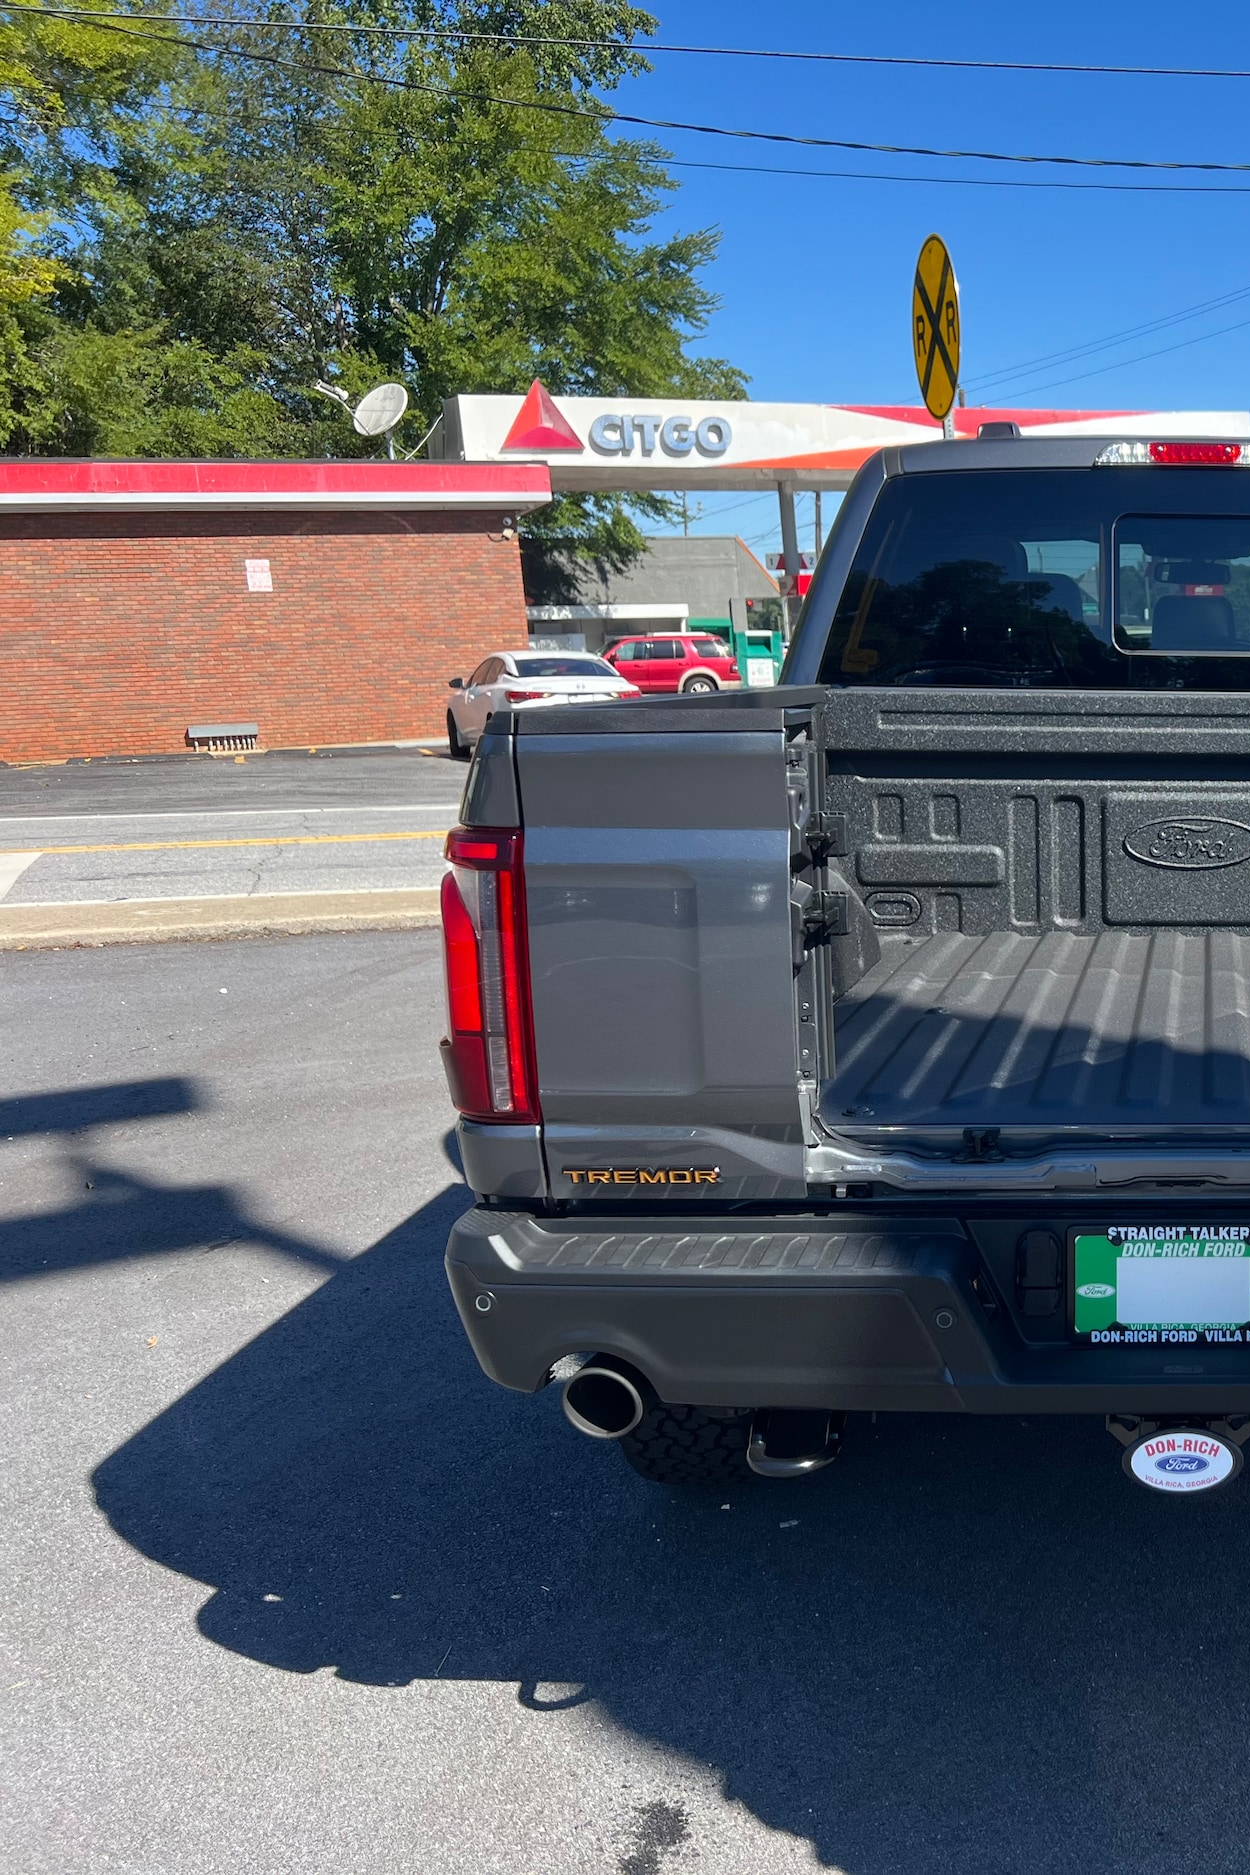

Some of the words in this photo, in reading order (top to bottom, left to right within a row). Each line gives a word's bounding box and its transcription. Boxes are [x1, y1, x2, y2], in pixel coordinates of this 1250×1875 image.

[916, 314, 927, 357] R
[945, 299, 957, 346] R
[589, 414, 732, 457] CITGO
[1149, 823, 1235, 859] Ford
[562, 1167, 721, 1184] TREMOR
[1107, 1226, 1186, 1240] STRAIGHT
[1121, 1242, 1199, 1257] DON-RICH
[1203, 1242, 1246, 1257] FORD
[1083, 1285, 1109, 1296] Ford
[1091, 1330, 1158, 1343] DON-RICH
[1161, 1330, 1197, 1343] FORD
[1204, 1329, 1243, 1342] VILLA
[1144, 1439, 1220, 1457] DON-RICH
[1165, 1457, 1198, 1470] Ford
[1145, 1474, 1164, 1486] VILLA
[1186, 1475, 1218, 1488] GEORGIA
